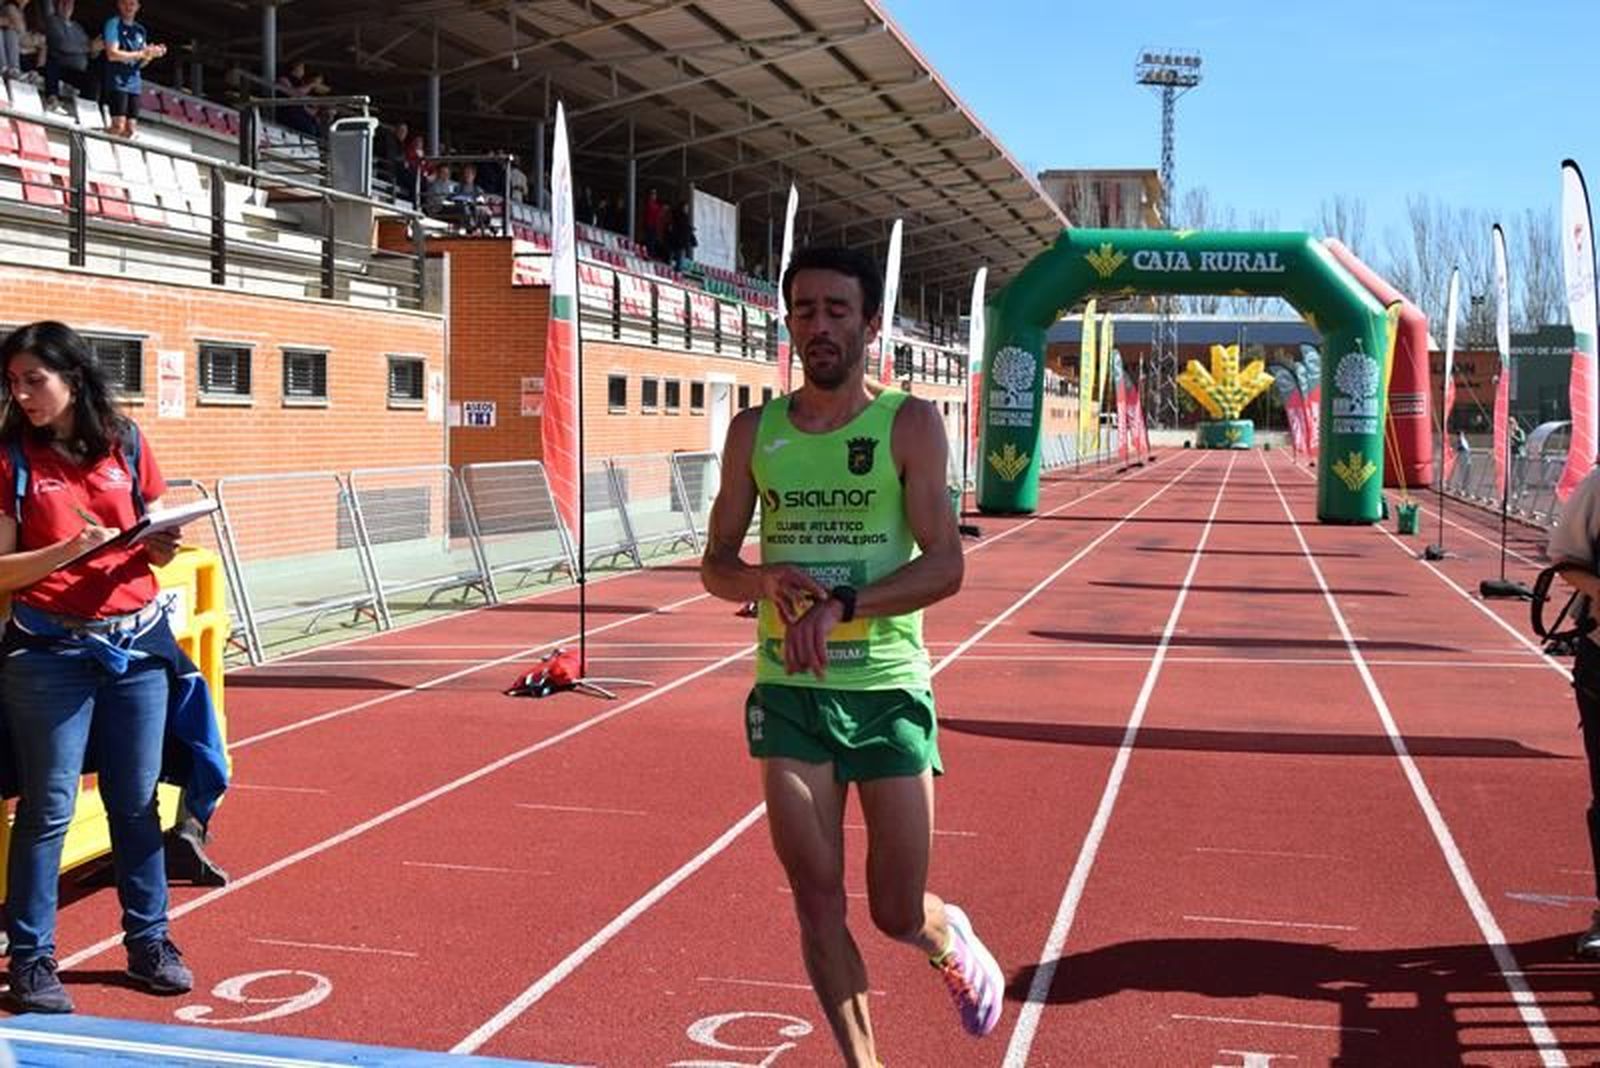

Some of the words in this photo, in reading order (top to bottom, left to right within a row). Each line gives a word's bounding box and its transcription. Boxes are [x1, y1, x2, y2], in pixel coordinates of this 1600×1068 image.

[1133, 251, 1192, 272] CAJA
[1199, 255, 1285, 273] RURAL
[776, 521, 807, 532] CLUBE
[799, 535, 813, 545] DE
